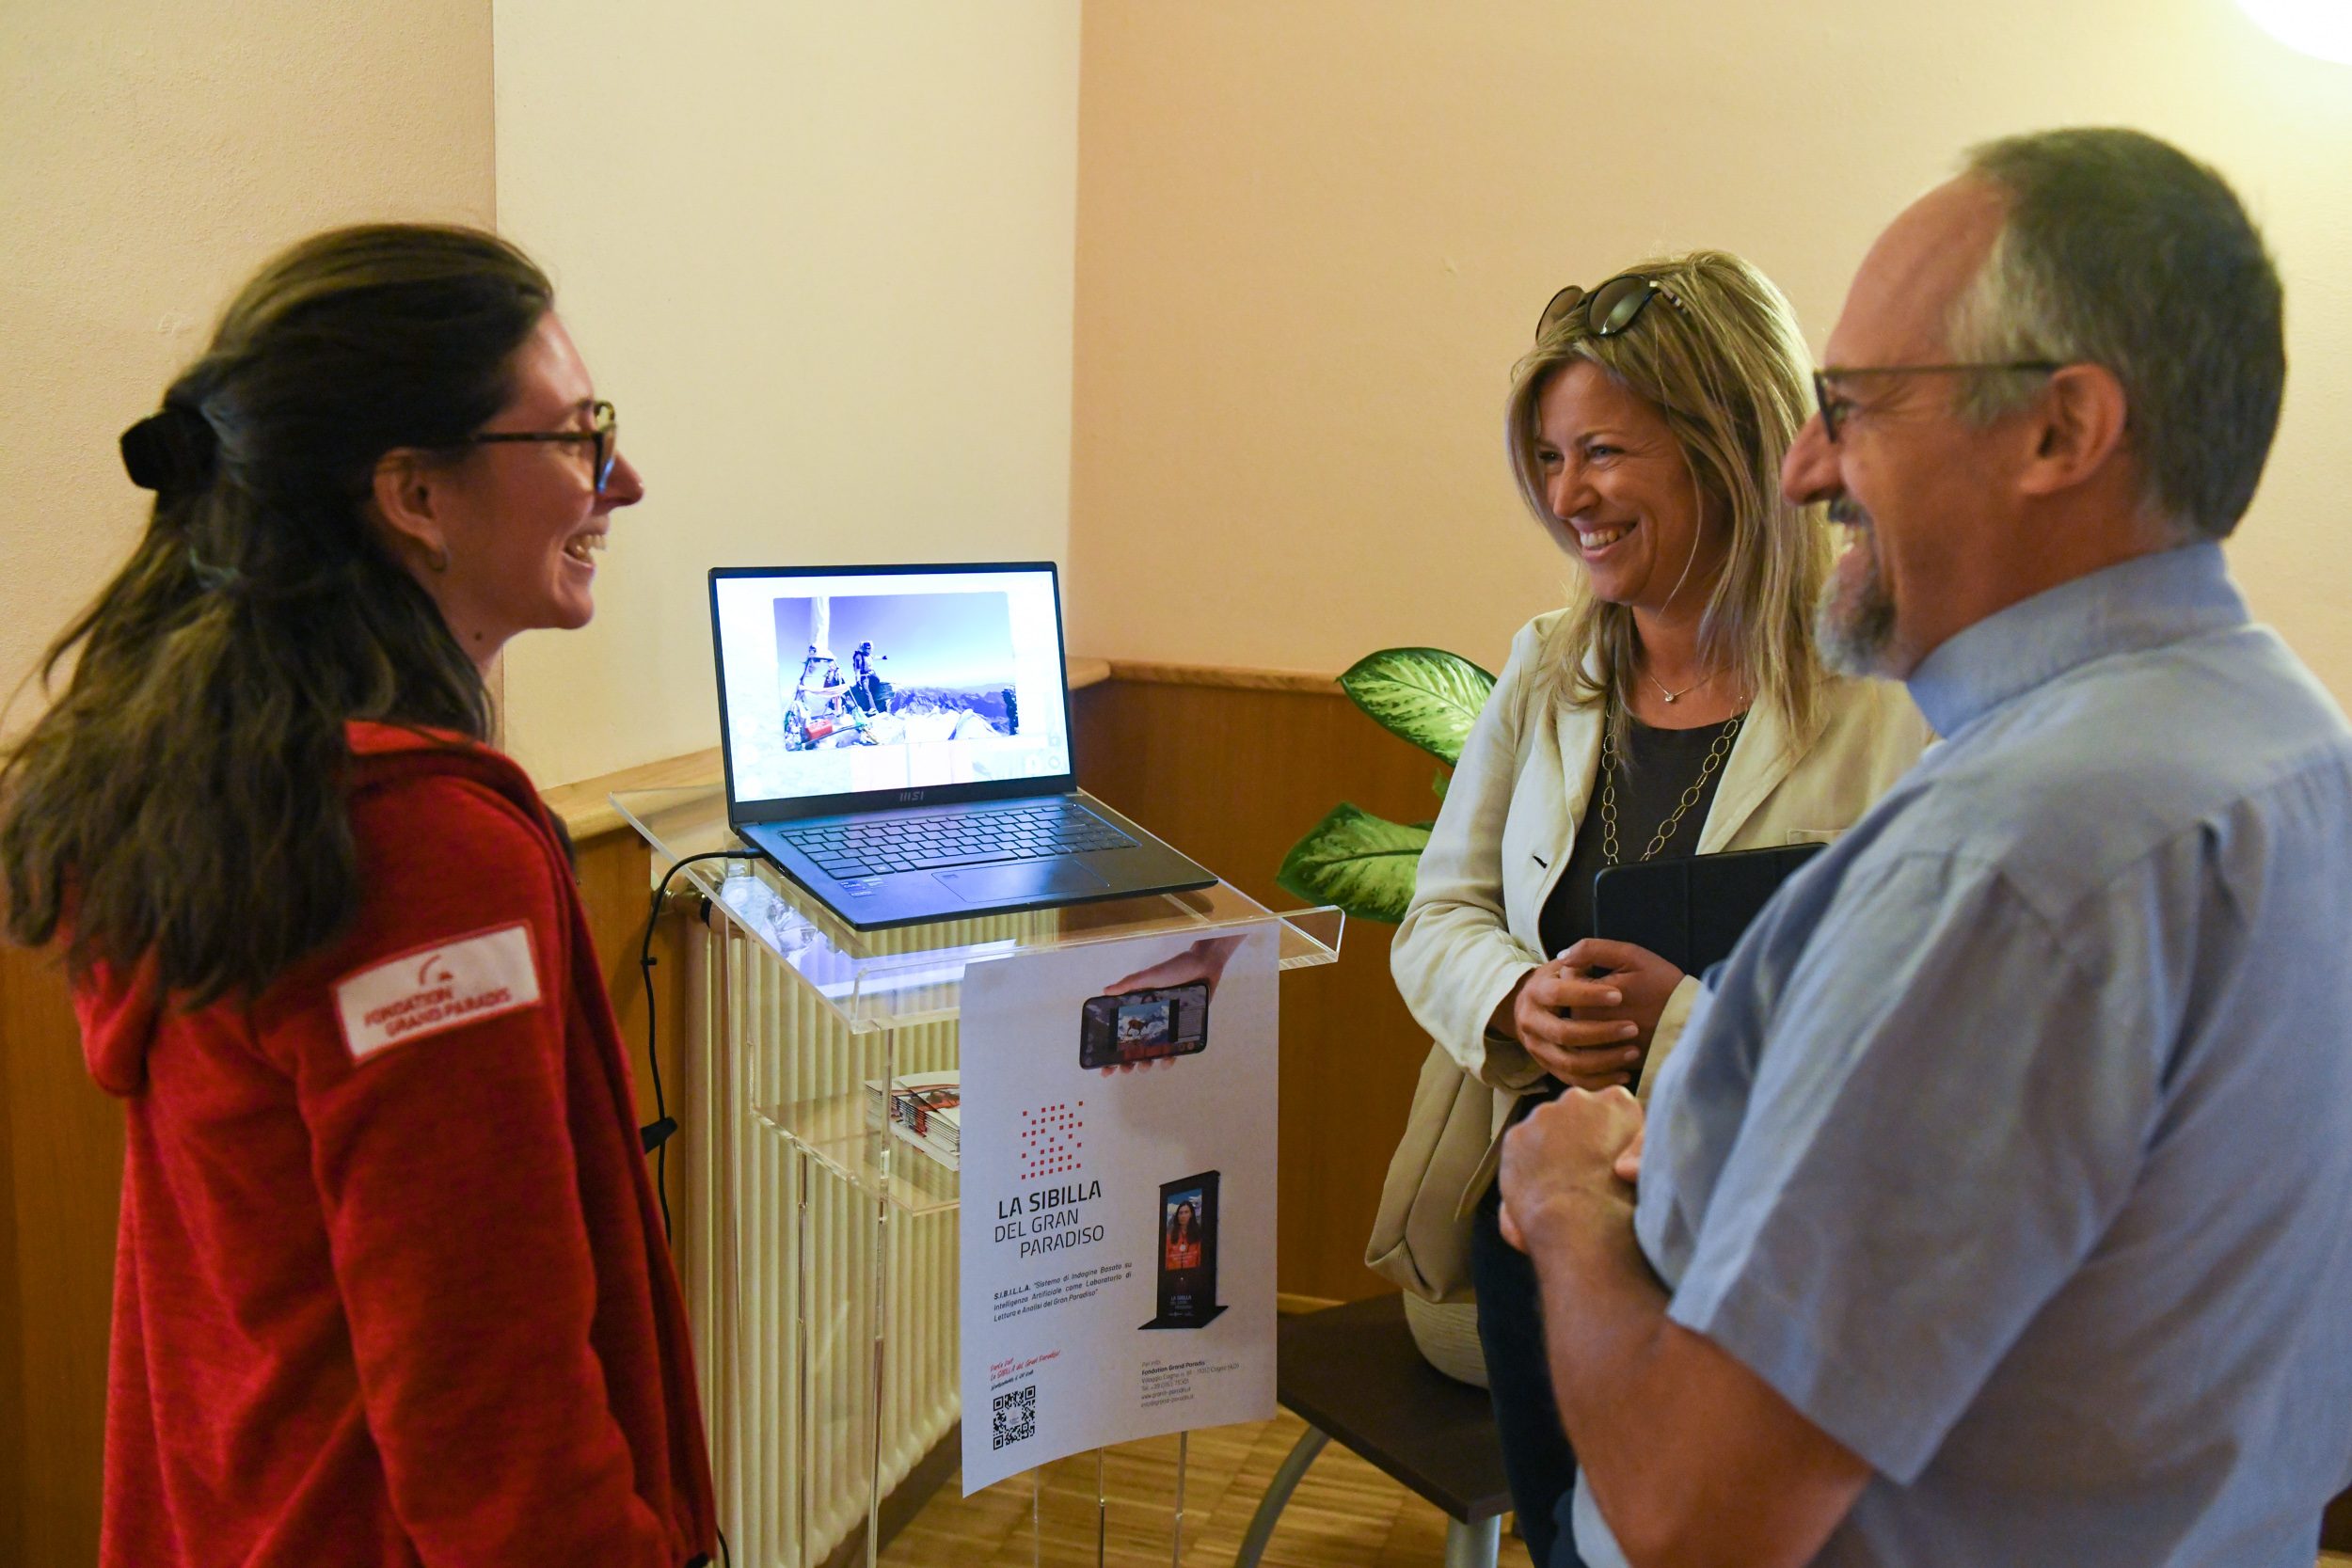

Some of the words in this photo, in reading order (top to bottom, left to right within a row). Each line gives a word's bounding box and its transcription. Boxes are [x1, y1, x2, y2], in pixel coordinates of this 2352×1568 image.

[998, 1196, 1023, 1220] LA
[1029, 1180, 1102, 1212] SIBILLA
[994, 1221, 1026, 1243] DEL
[1032, 1209, 1078, 1233] GRAN
[1021, 1225, 1104, 1259] PARADISO
[994, 1285, 1031, 1300] S.I.B.I.L.L.A.
[1063, 1274, 1070, 1282] di
[1072, 1269, 1097, 1281] Indagine
[1100, 1264, 1121, 1274] Basato
[1031, 1289, 1061, 1300] Artificiale
[1065, 1283, 1082, 1292] come
[1086, 1274, 1121, 1287] Laboratorio
[993, 1311, 1016, 1323] Lettura
[1022, 1303, 1042, 1313] Analisi
[1043, 1300, 1053, 1308] del
[1054, 1296, 1068, 1306] Gran
[1142, 1367, 1168, 1376] Fondation
